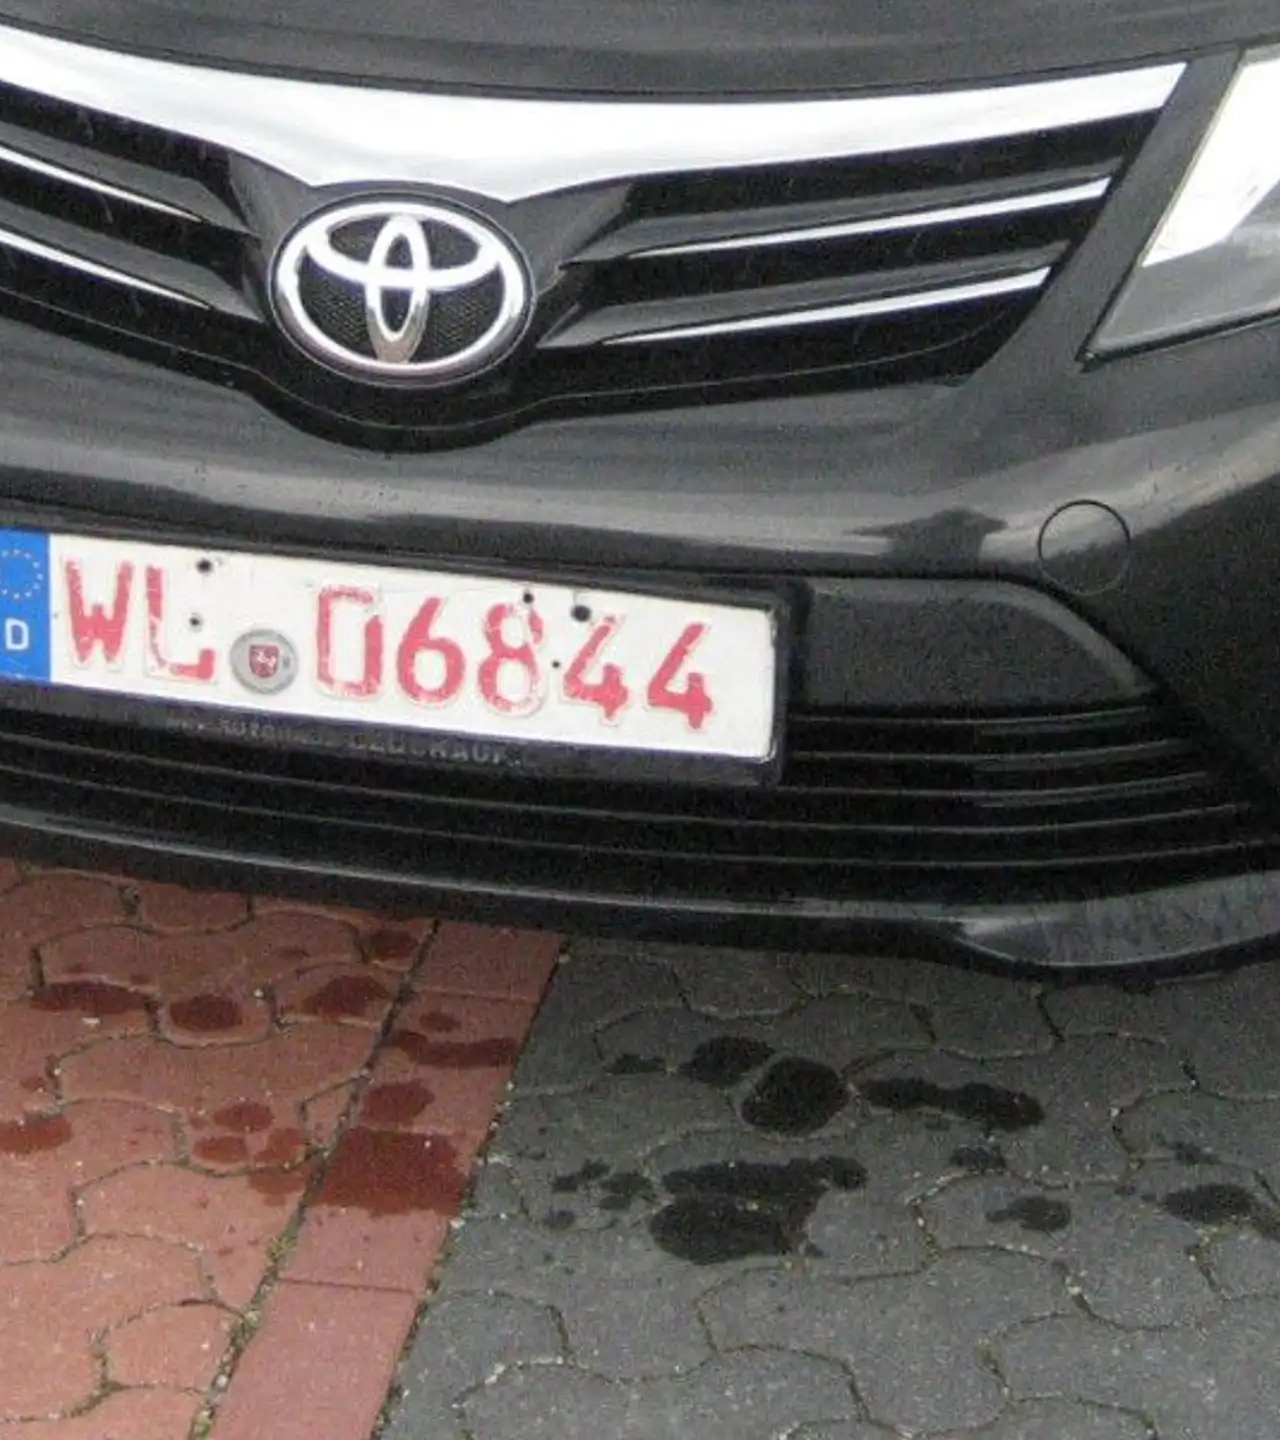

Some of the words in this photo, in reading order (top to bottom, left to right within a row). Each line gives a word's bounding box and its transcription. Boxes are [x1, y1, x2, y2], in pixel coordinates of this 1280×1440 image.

[4, 617, 30, 650] D
[65, 559, 217, 681] WL
[316, 584, 714, 730] 06844
